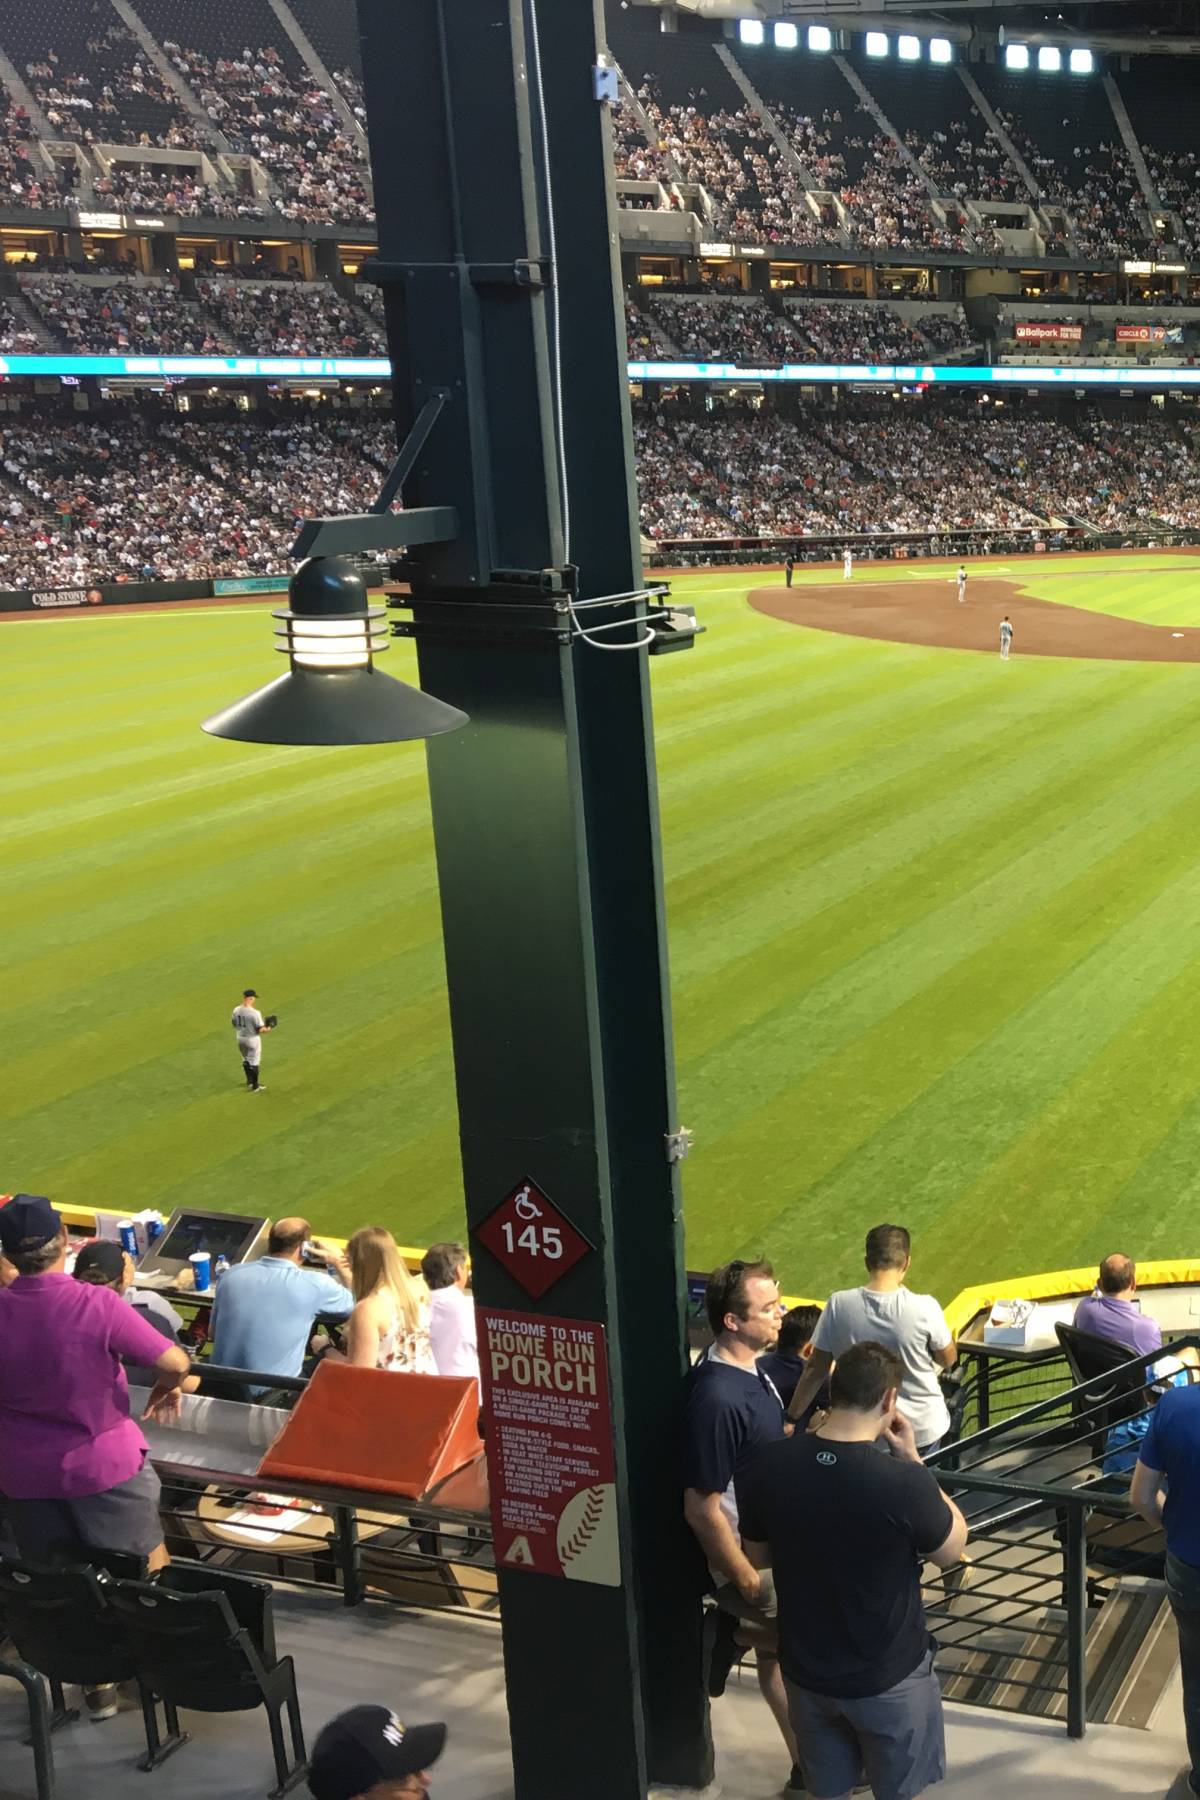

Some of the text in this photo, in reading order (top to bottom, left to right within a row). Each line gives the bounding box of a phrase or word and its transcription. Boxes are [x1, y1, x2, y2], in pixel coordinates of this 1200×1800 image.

[1026, 328, 1058, 338] Ballpark
[32, 592, 56, 605] COLD
[57, 591, 88, 602] STONE
[501, 1221, 563, 1260] 145
[486, 1318, 595, 1345] WELCOME TO THE
[488, 1332, 595, 1364] HOME RUN
[491, 1352, 597, 1395] PORCH
